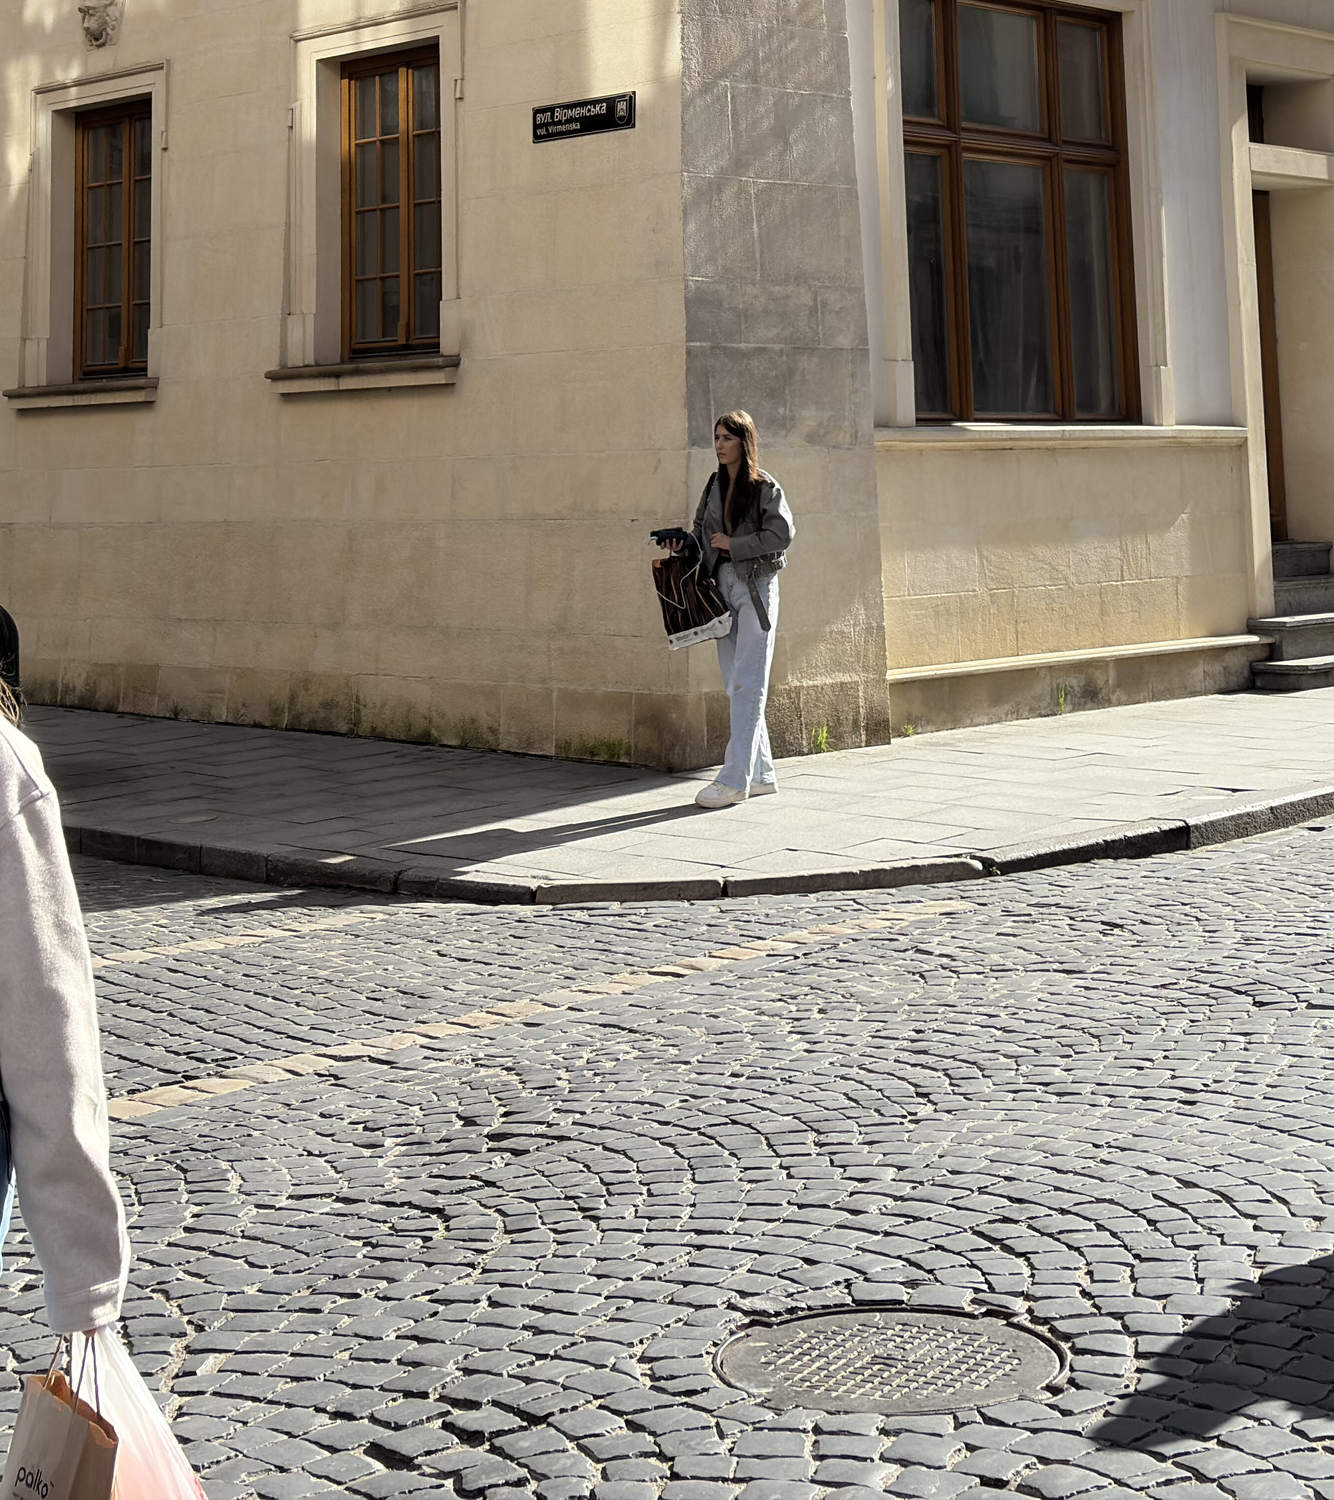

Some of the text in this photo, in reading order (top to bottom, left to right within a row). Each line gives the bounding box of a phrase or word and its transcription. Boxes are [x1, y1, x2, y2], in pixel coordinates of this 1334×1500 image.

[536, 102, 607, 124] вул. Вірменська
[548, 122, 580, 134] Virmenska
